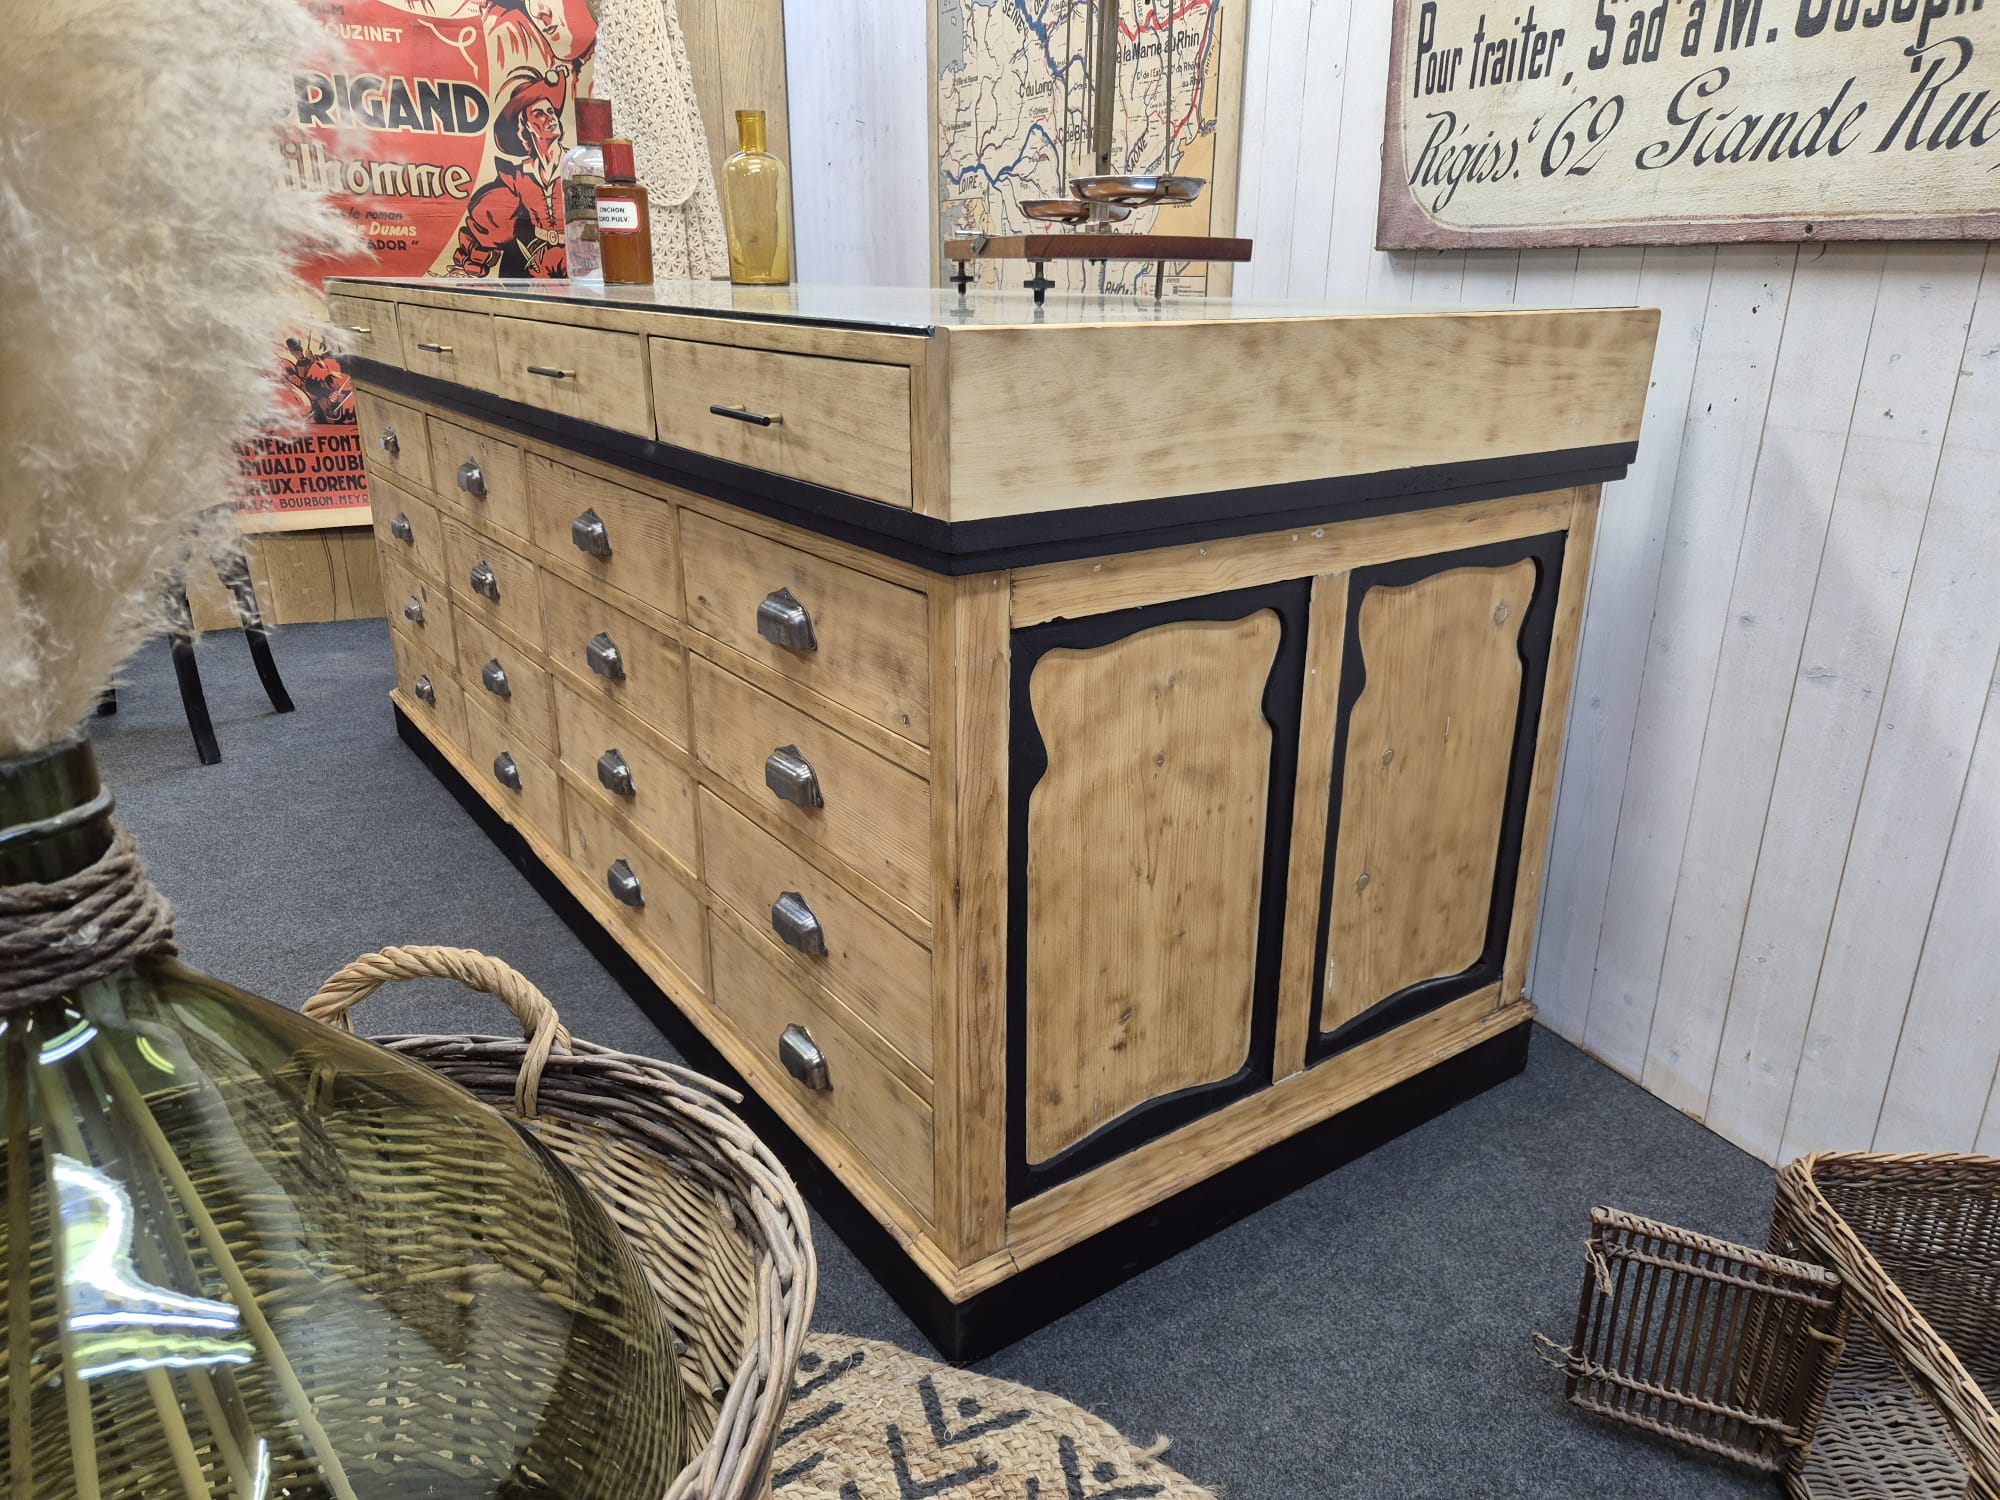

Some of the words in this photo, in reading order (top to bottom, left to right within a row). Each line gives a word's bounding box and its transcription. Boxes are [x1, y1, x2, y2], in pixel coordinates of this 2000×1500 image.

[324, 23, 403, 43] OUZINET
[1178, 28, 1200, 50] Rhin
[1413, 1, 1462, 98] Pour
[291, 71, 490, 135] RIGAND
[283, 142, 472, 199] ilhomme
[959, 174, 979, 195] LOIRE
[365, 210, 404, 220] roman
[369, 221, 417, 236] DUMAS
[317, 434, 362, 454] FONT
[311, 451, 365, 474] JOUB
[300, 474, 368, 494] FLORENC
[339, 493, 369, 505] MEYR
